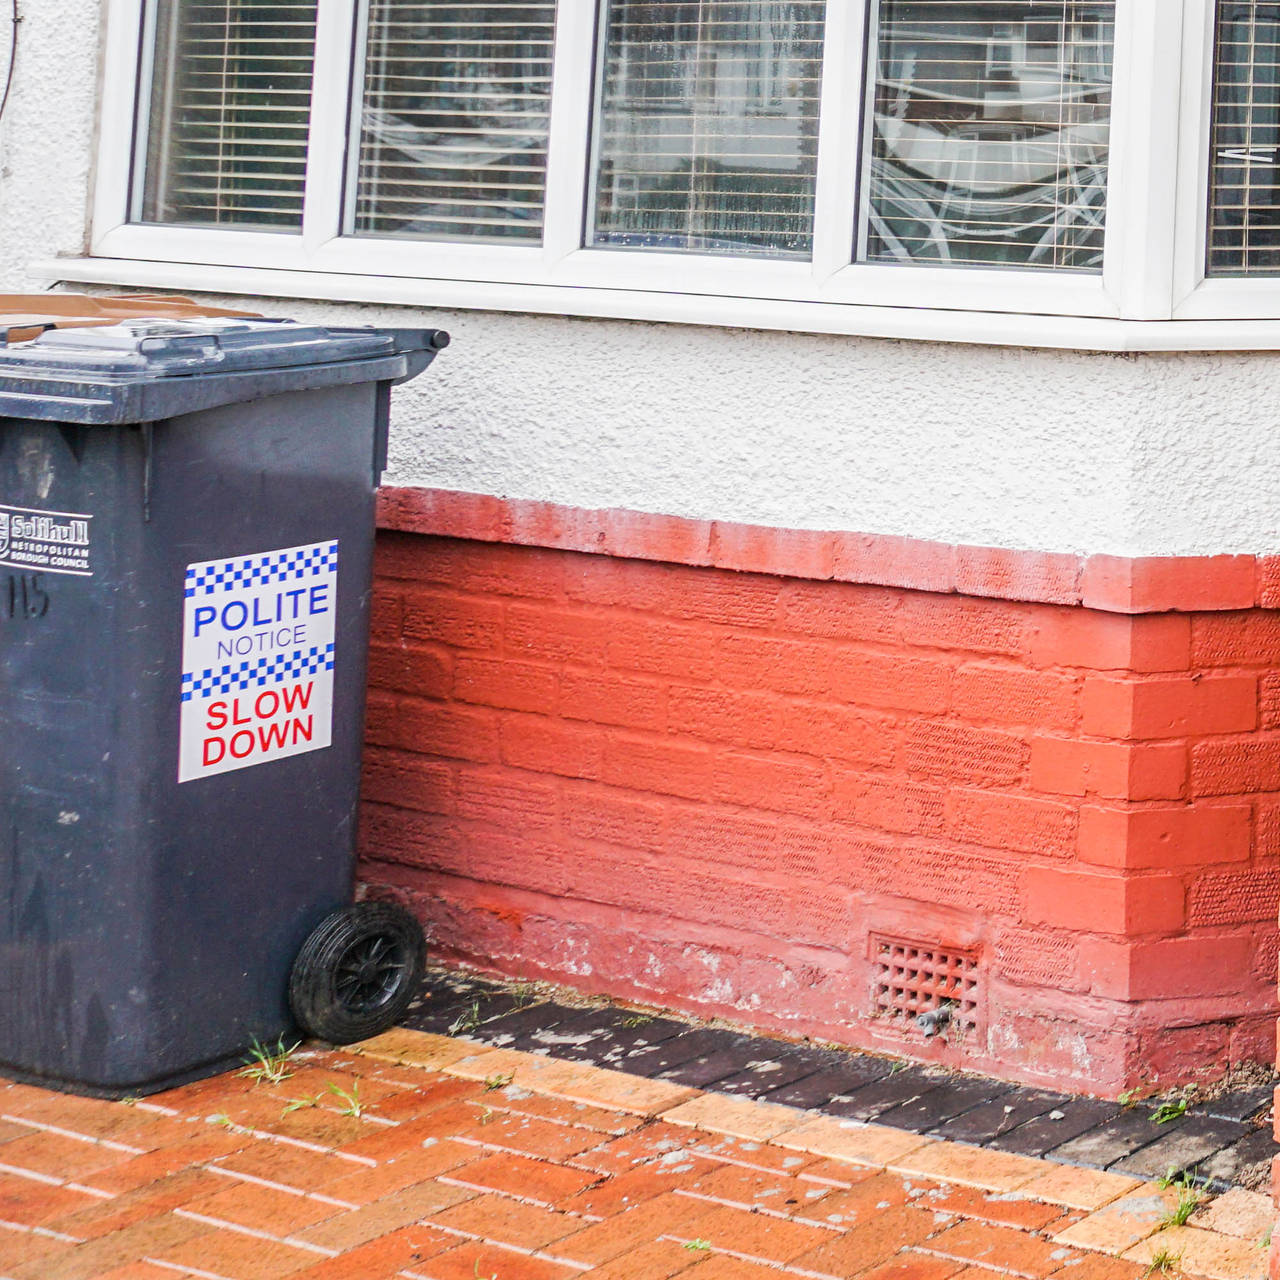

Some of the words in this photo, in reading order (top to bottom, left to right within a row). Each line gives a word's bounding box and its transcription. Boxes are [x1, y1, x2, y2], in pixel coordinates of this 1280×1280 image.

[11, 515, 88, 543] Solihull
[11, 541, 89, 557] METROPOLITAN
[10, 551, 49, 564] BOROUGH
[50, 556, 90, 569] COUNCIL
[8, 573, 50, 618] 115
[194, 584, 328, 637] POLITE
[217, 624, 306, 659] NOTICE
[206, 681, 313, 731] SLOW
[202, 714, 313, 766] DOWN
